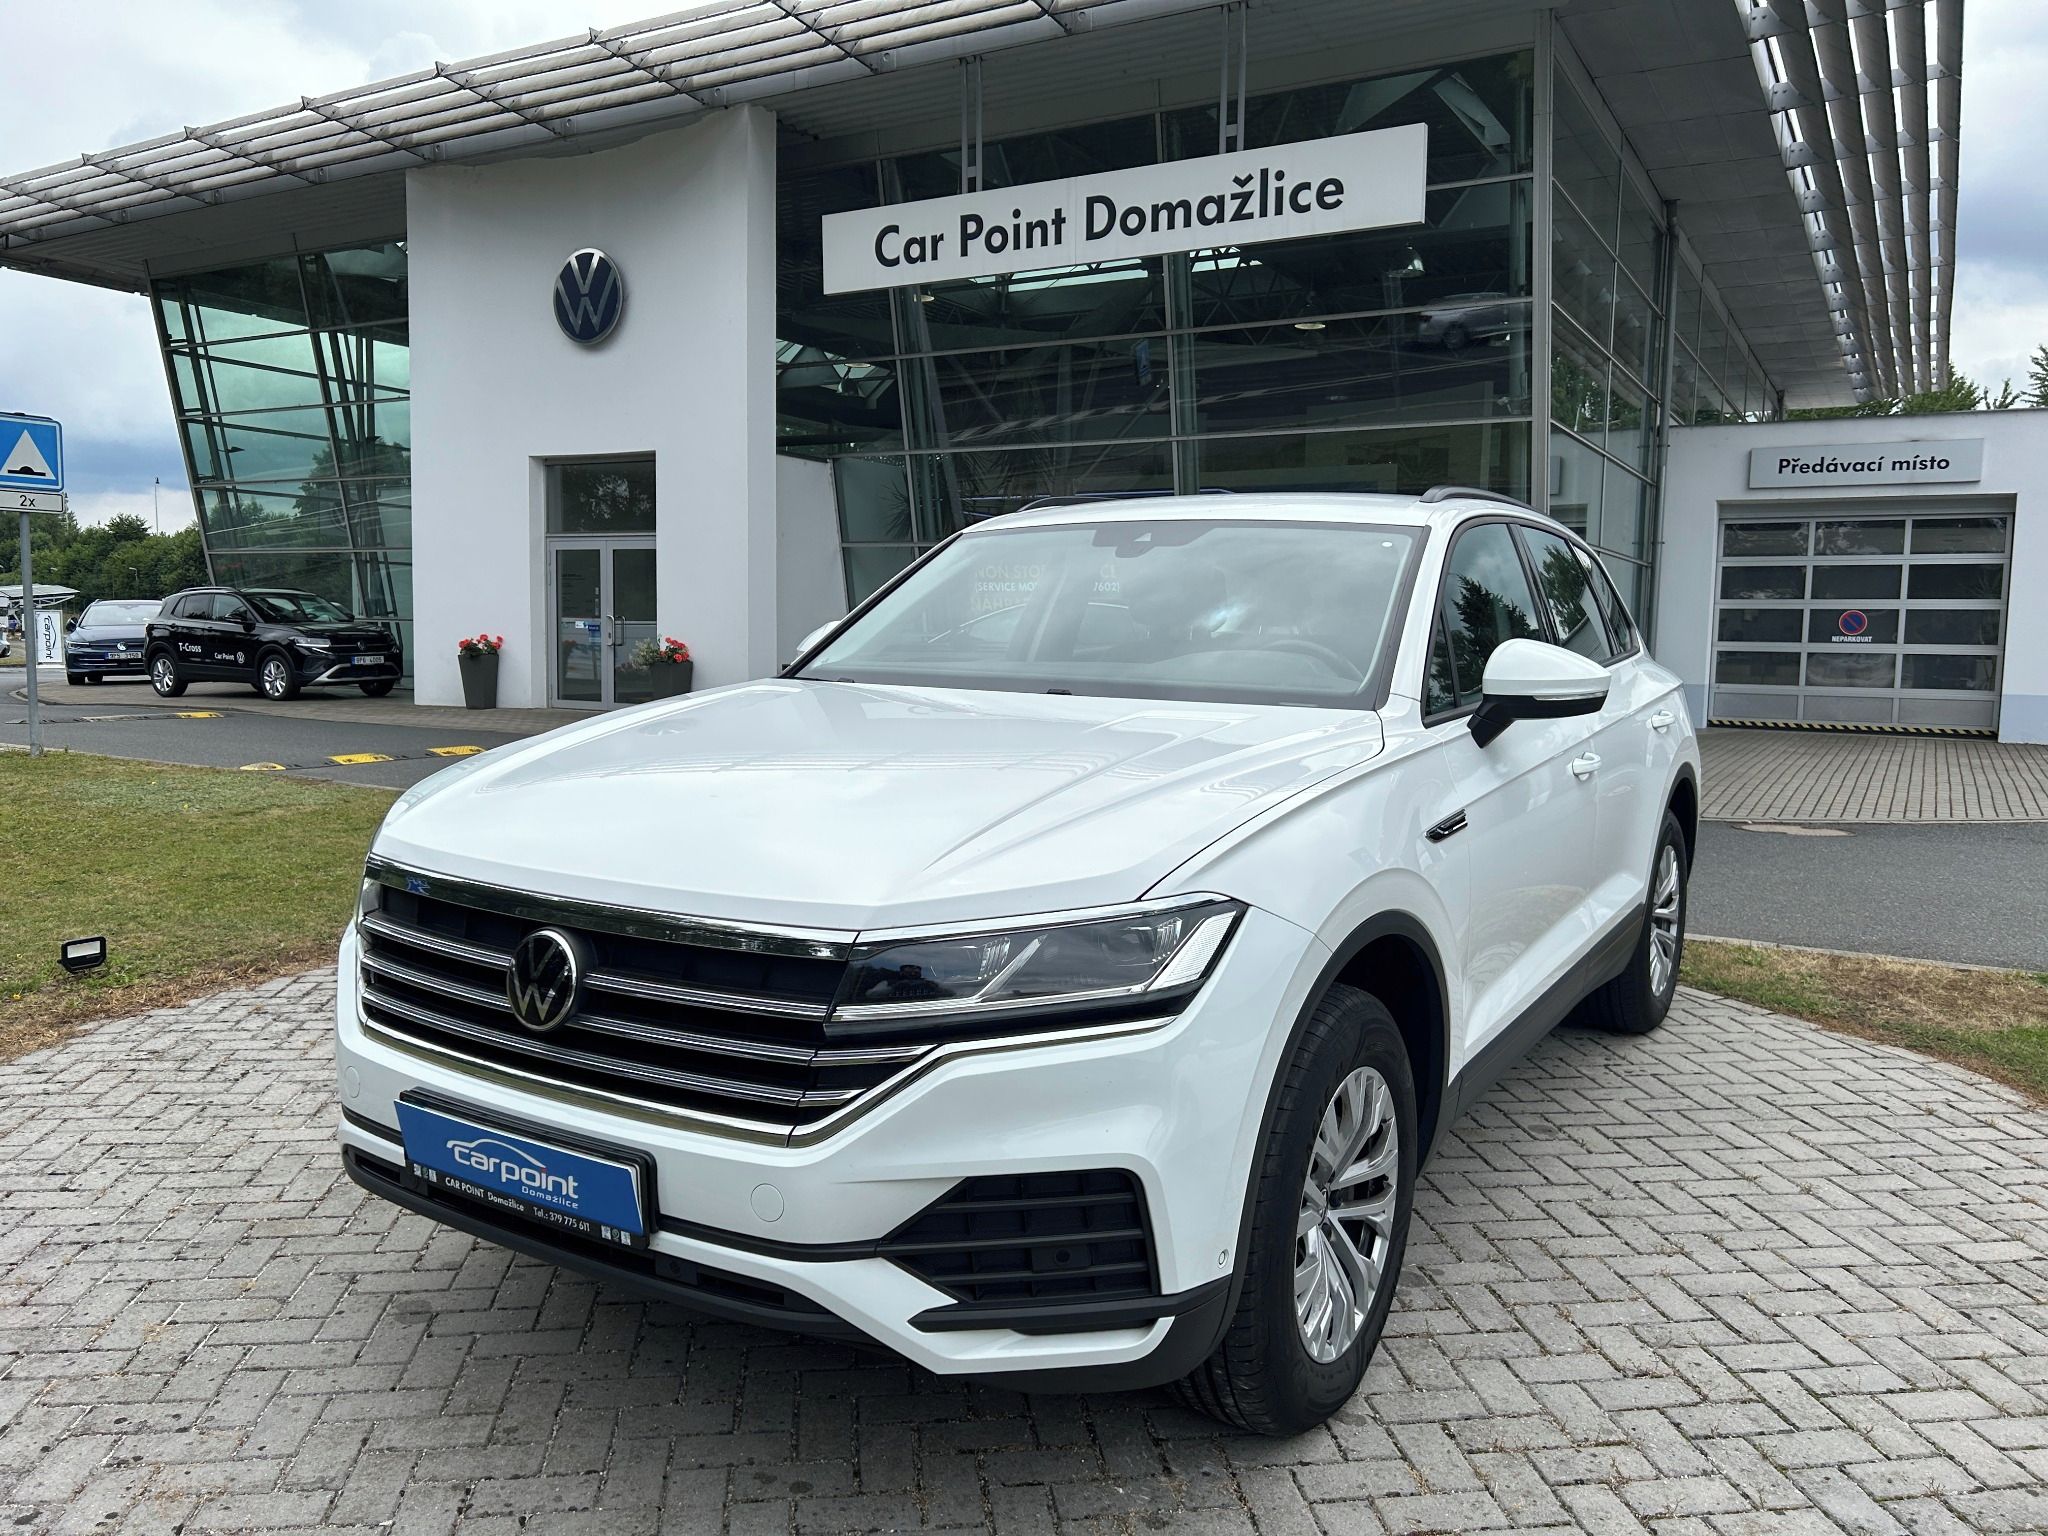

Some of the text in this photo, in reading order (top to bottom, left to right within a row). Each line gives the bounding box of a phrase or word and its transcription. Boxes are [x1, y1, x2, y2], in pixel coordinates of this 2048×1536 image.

[875, 167, 1345, 268] Car Point Domažlice
[1777, 454, 1950, 475] Předávací místo
[19, 494, 36, 508] 2x
[43, 616, 54, 659] carpoint
[178, 642, 202, 653] T-Cross
[1831, 635, 1873, 643] NEPARKOVAT
[214, 652, 222, 660] Car
[222, 653, 235, 661] Point
[453, 1145, 579, 1199] carpoint
[445, 1176, 591, 1232] CAR POINT Domažlice Tel.: 379 775 611
[521, 1185, 579, 1210] Domažlice
